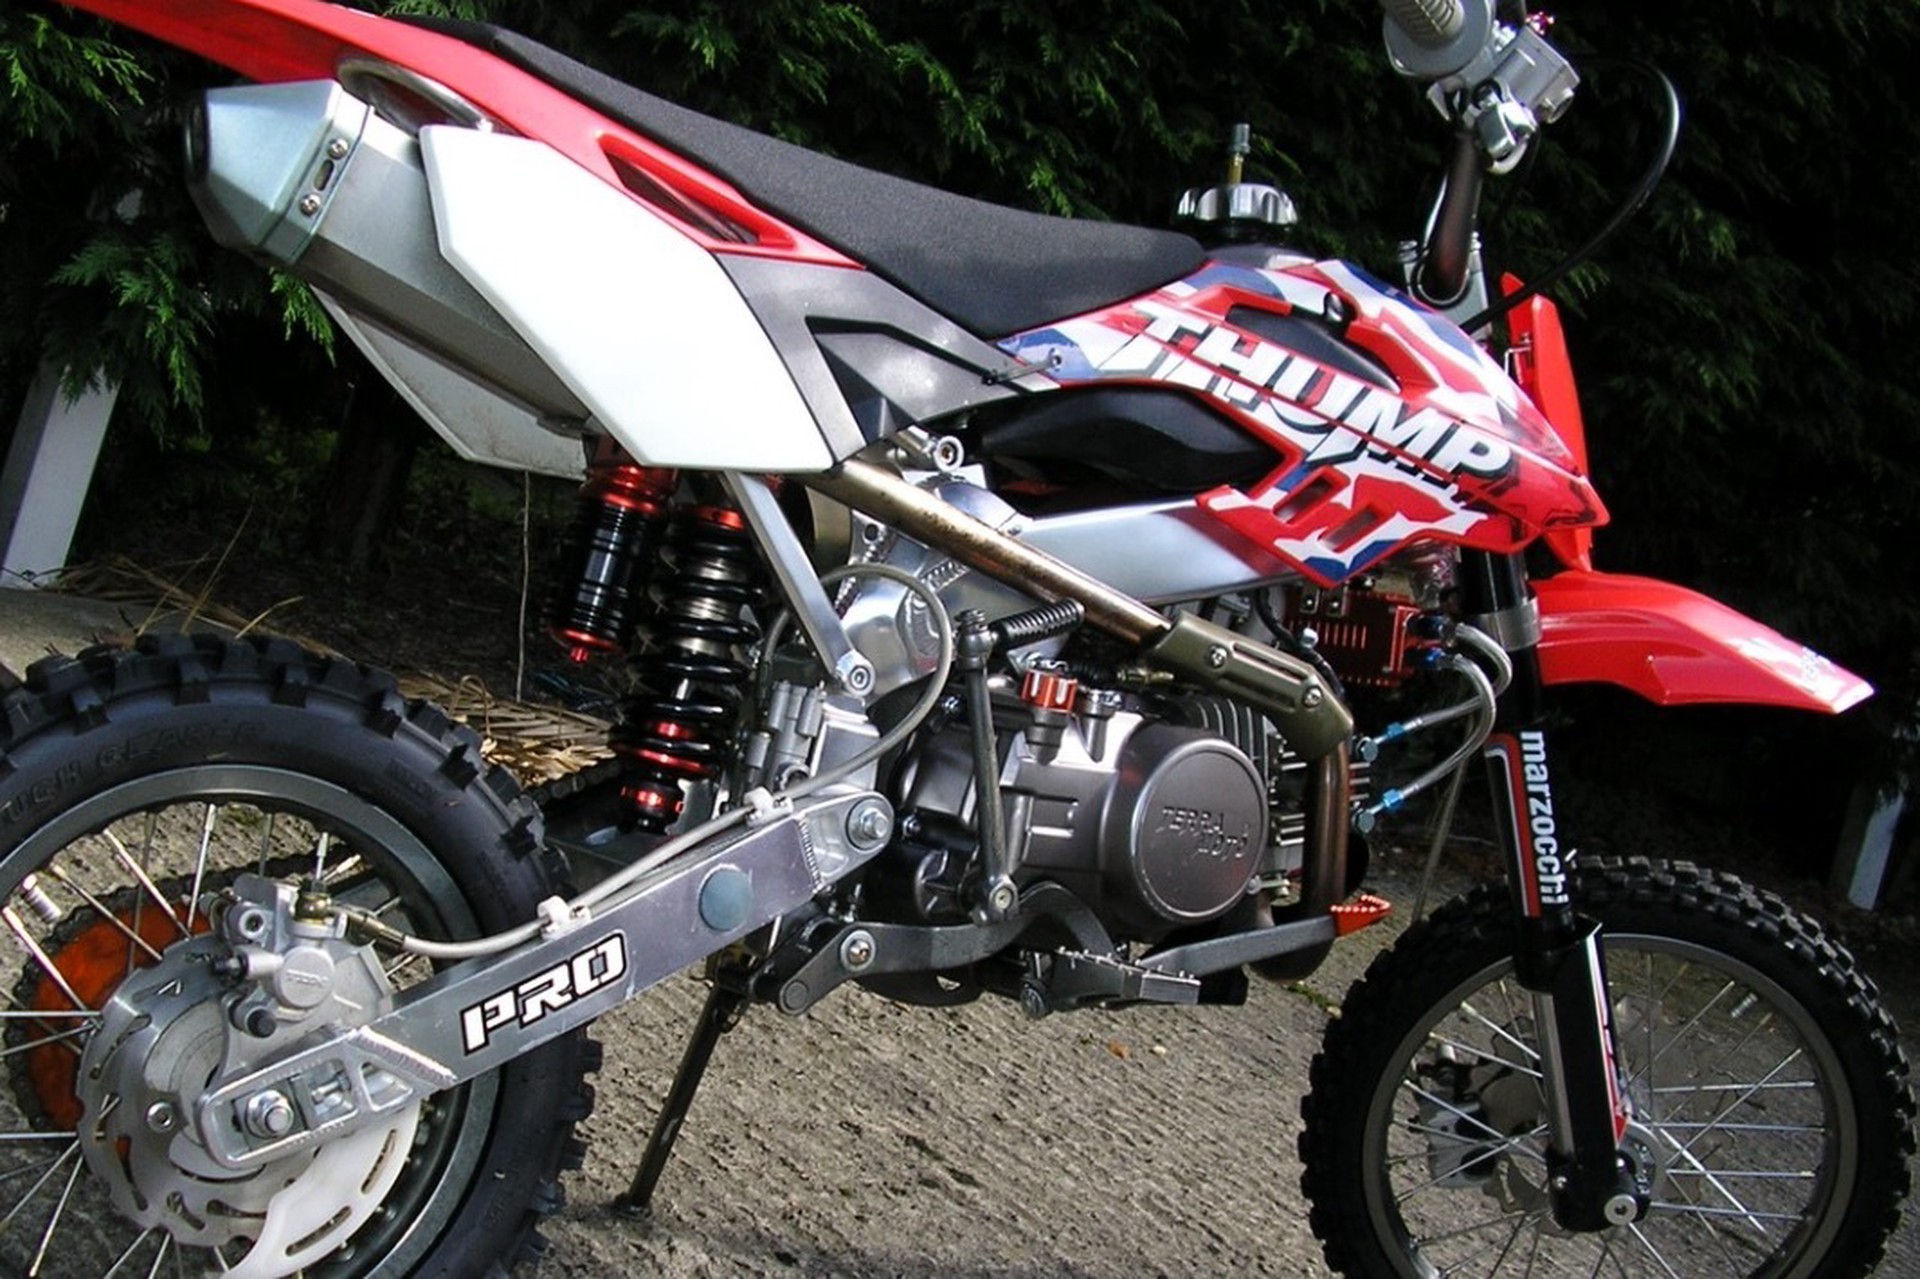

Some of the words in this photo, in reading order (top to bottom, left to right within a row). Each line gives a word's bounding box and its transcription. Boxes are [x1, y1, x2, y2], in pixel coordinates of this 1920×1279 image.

[1096, 299, 1516, 488] THUMP
[1520, 731, 1570, 904] marzocchi
[460, 930, 627, 1056] PRO
